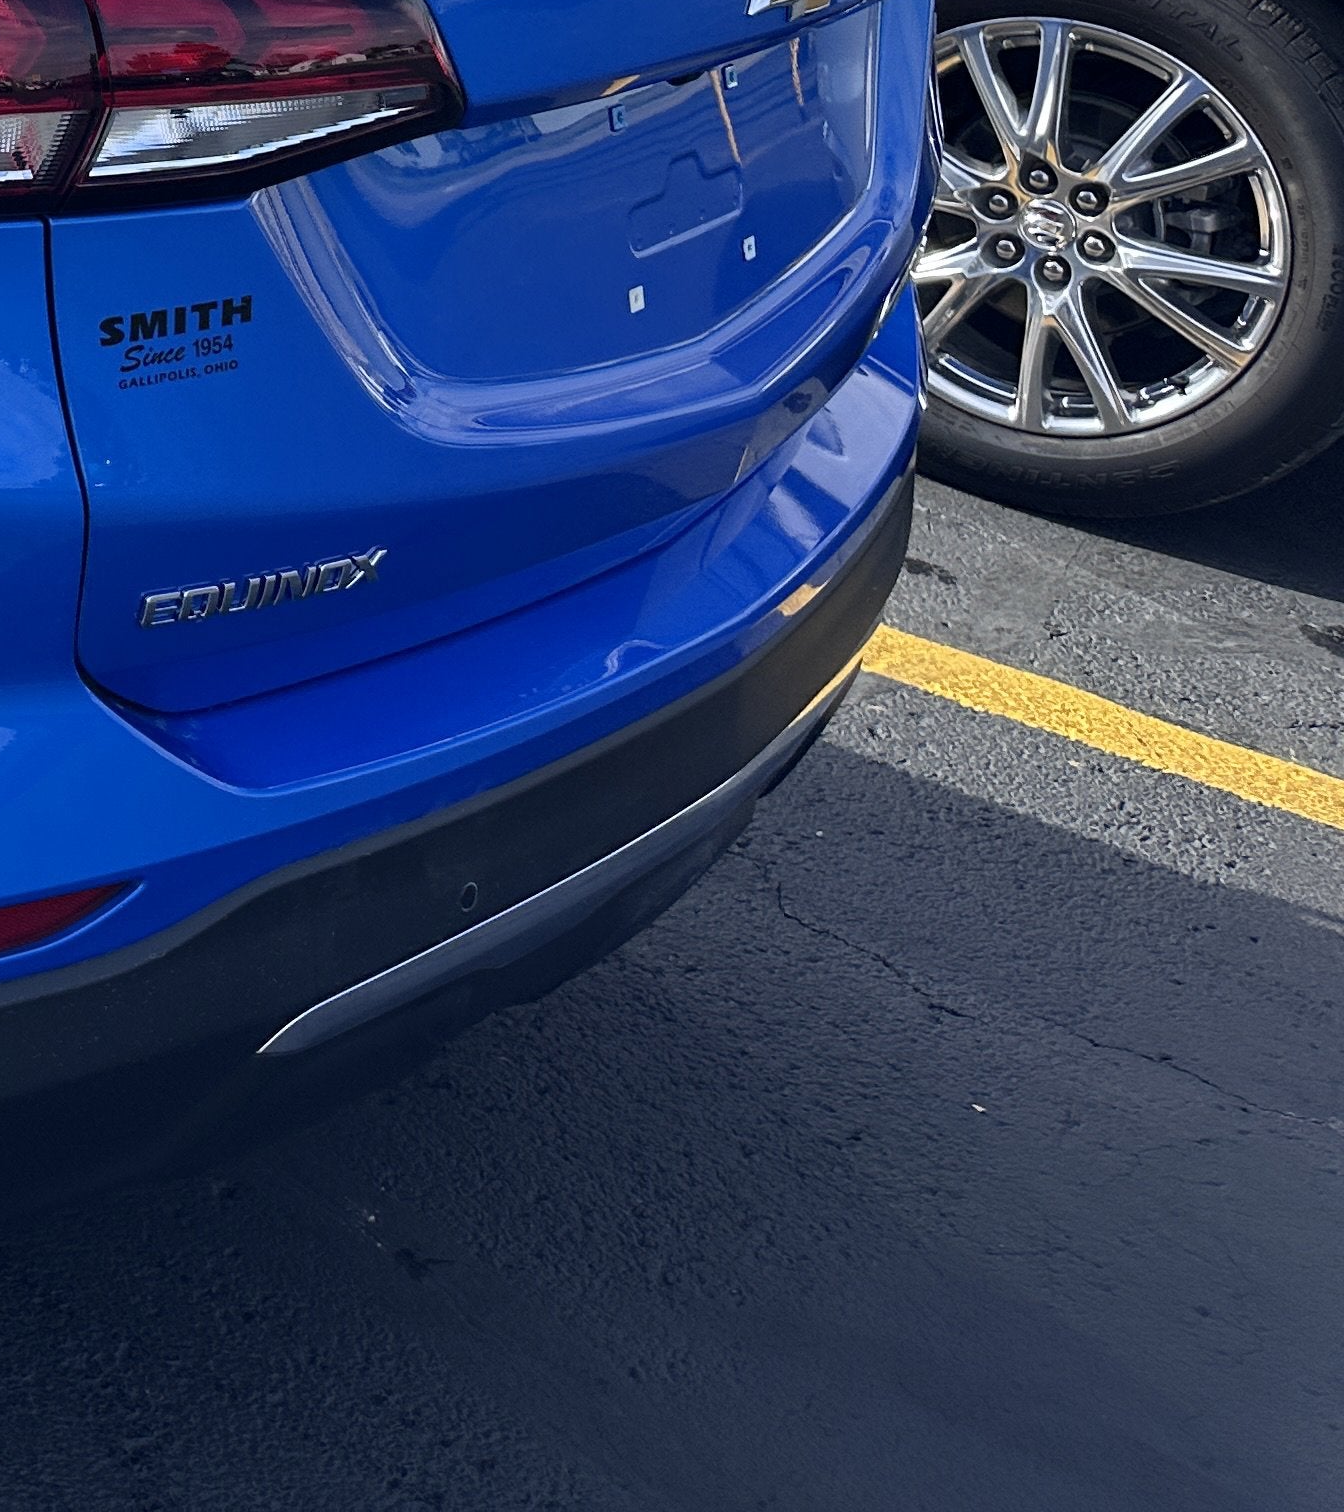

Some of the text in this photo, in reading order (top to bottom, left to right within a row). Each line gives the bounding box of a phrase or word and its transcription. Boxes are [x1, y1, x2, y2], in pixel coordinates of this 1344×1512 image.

[99, 295, 253, 347] SMITH
[120, 334, 234, 373] Since 1954
[204, 359, 239, 375] OHIO
[137, 545, 388, 628] EQUINOX
